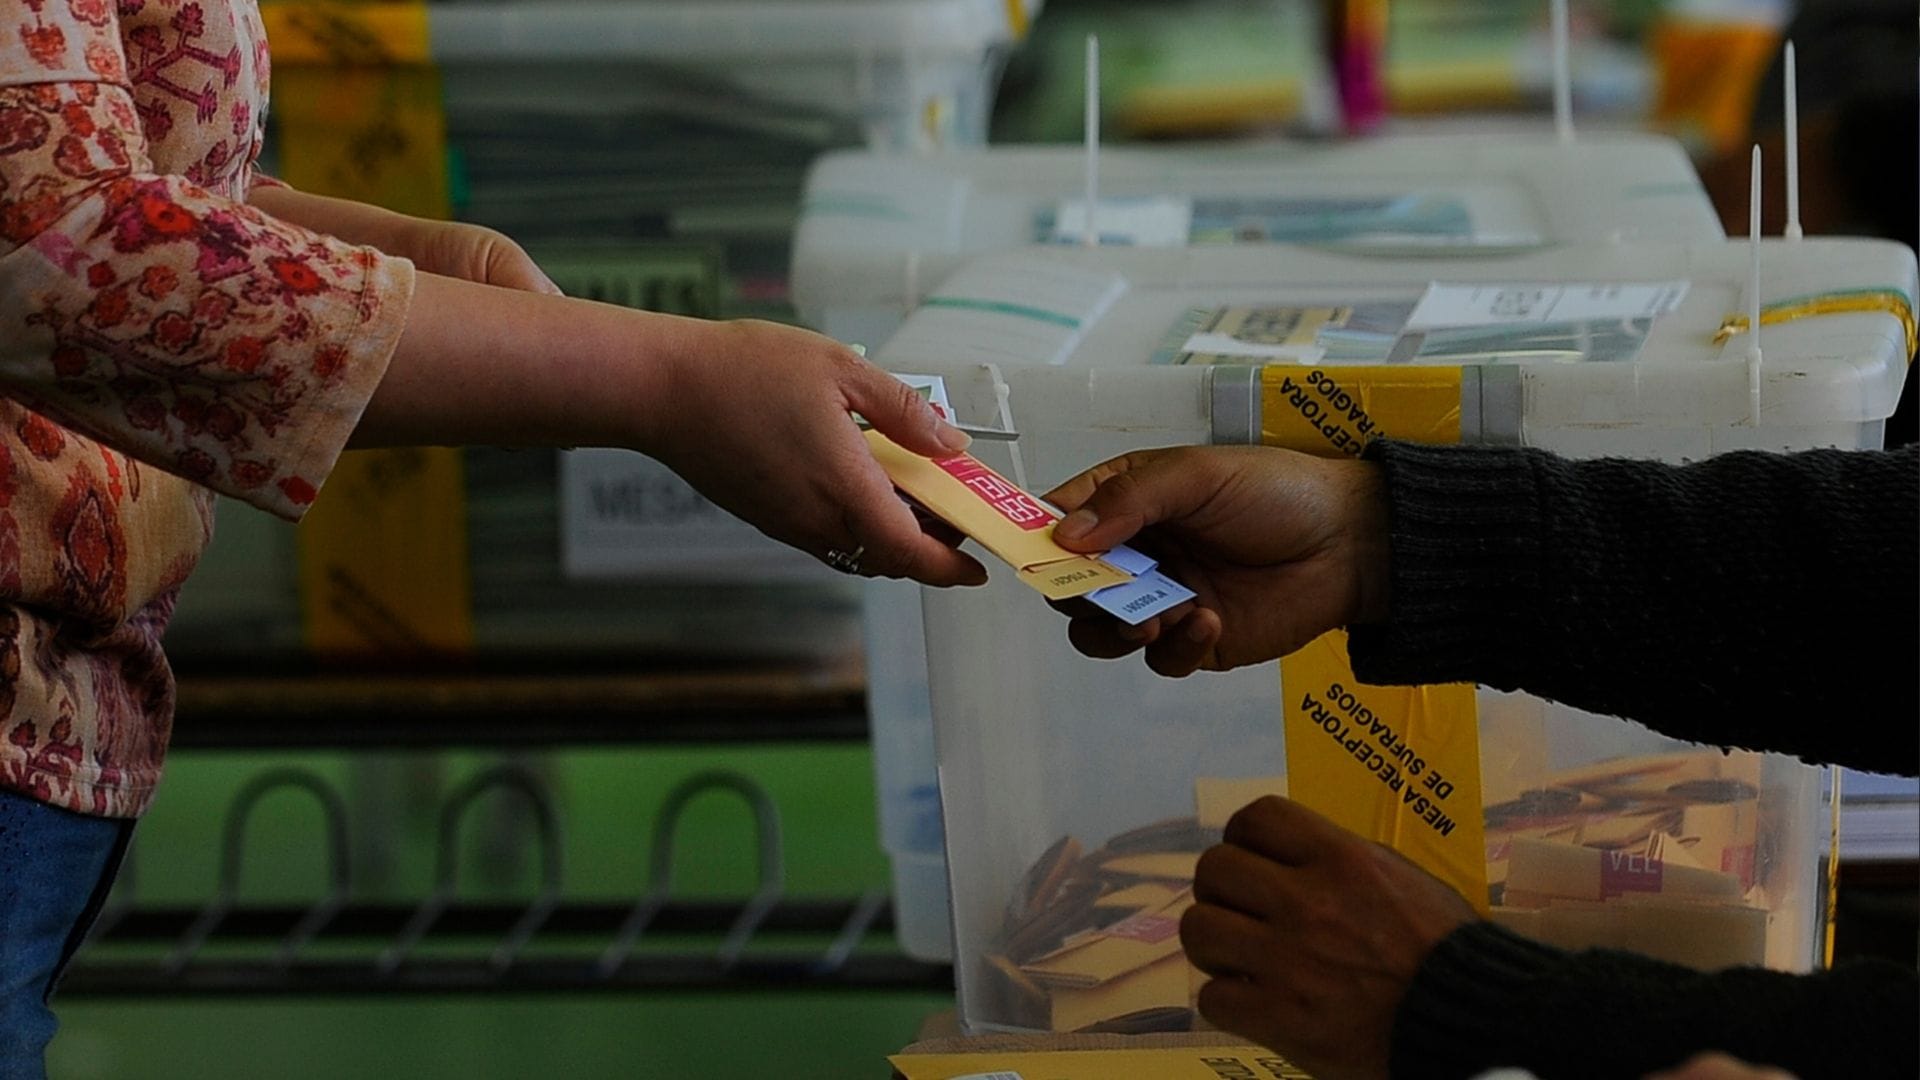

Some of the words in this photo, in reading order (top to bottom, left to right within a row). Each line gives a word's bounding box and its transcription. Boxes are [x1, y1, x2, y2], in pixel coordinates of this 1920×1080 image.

[965, 474, 1019, 500] VEL
[994, 495, 1044, 522] SER
[1301, 693, 1405, 793] RECEPTORA
[1326, 683, 1426, 776] SUFRAGIOS
[1421, 770, 1455, 800] DE
[1402, 785, 1456, 837] MESA
